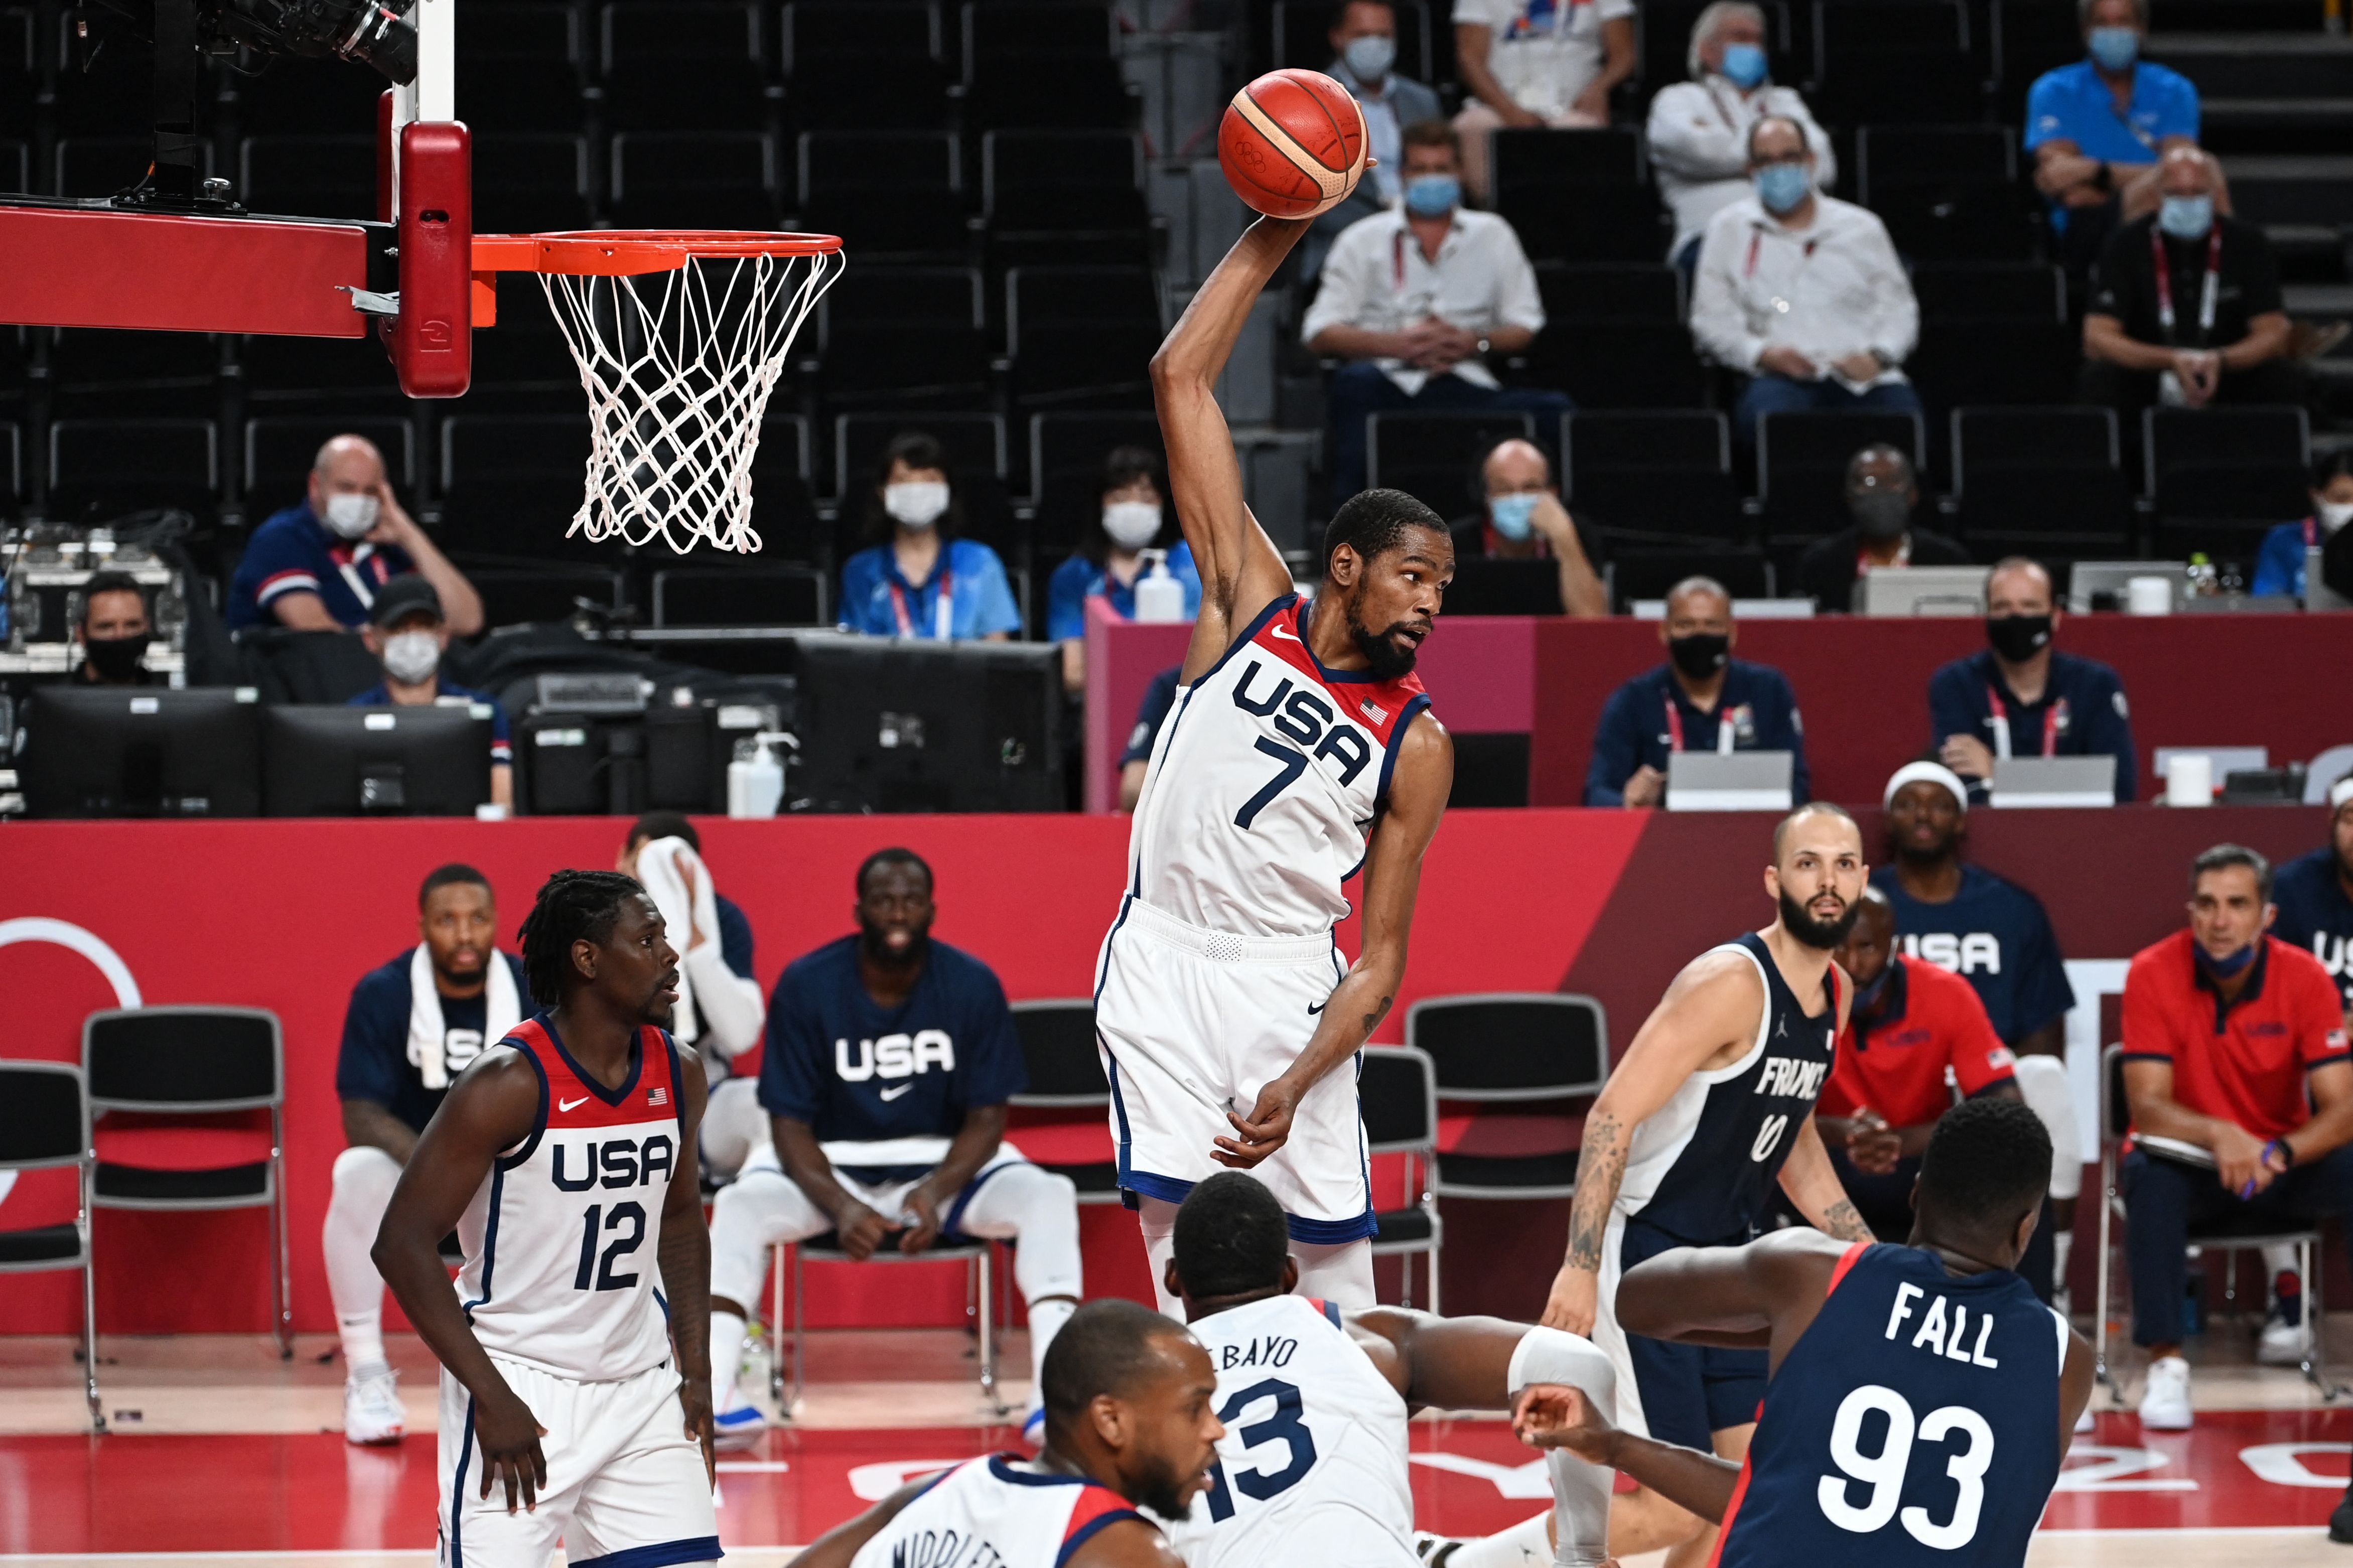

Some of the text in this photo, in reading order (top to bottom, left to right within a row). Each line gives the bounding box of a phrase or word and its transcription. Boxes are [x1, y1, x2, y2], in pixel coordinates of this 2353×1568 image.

[1232, 660, 1370, 788] USA
[1233, 735, 1309, 830] 7
[835, 1029, 955, 1082] USA
[552, 1134, 672, 1192] USA
[1750, 1114, 1788, 1163] 10
[574, 1201, 646, 1292] 12
[1206, 1336, 1298, 1373] BAYO
[1885, 1281, 1998, 1369] FALL
[1818, 1384, 1995, 1550] 93
